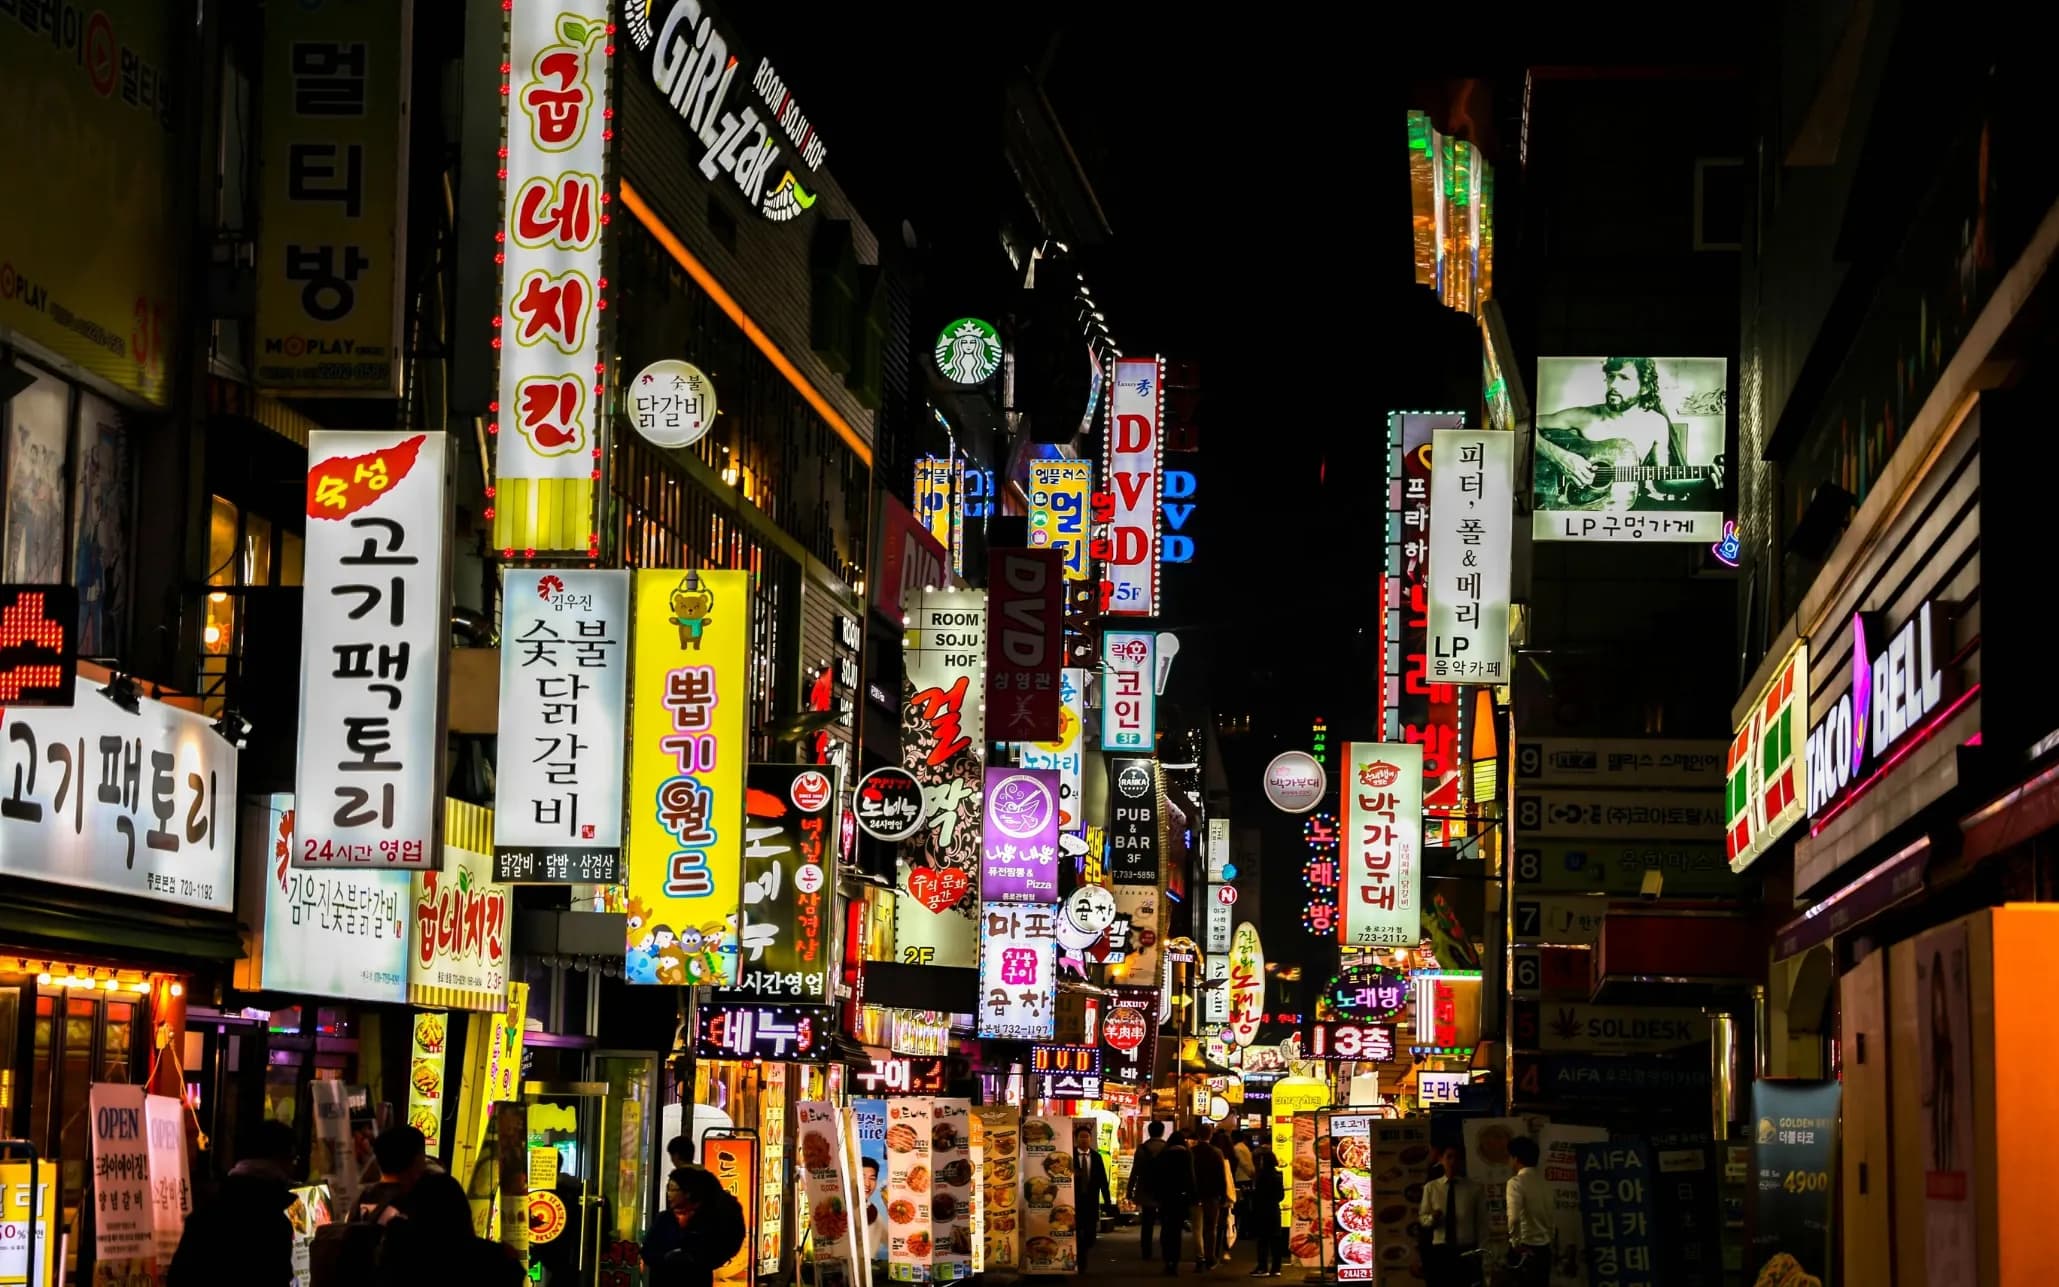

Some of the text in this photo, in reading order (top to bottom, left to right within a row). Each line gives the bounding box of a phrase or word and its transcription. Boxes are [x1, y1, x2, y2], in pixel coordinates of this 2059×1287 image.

[753, 57, 788, 113] ROOM
[287, 43, 368, 322] 멀티방
[517, 52, 591, 447] 굽네치킨
[671, 375, 703, 391] 숯불
[636, 394, 705, 428] 닭갈비
[315, 458, 387, 510] 숙성
[1035, 468, 1087, 485] 엠플러스
[1114, 414, 1151, 566] DVD
[1161, 470, 1197, 563] DVD
[1404, 478, 1429, 564] 프라하
[1565, 516, 1694, 539] LP 구멍가게
[1455, 442, 1487, 631] 피터, 폴 & 메리
[551, 593, 593, 612] 김우진
[1116, 582, 1142, 601] 5F
[932, 613, 979, 626] ROOM
[1003, 555, 1048, 668] DVD
[515, 619, 617, 668] 숯불
[935, 634, 978, 647] SOJU
[1435, 636, 1469, 658] LP
[331, 517, 419, 829] 고기팩토리
[945, 655, 978, 667] HOF
[1434, 661, 1501, 677] 음악카페
[1115, 670, 1142, 729] 코인
[1804, 599, 1942, 820] TACO BELL
[1120, 734, 1137, 743] 3F
[532, 674, 589, 837] 닭갈비
[1520, 746, 1539, 775] 9
[660, 670, 714, 895] 뽑기월드
[1270, 777, 1319, 790] 박가부대
[1, 721, 217, 870] 고기팩토리
[1117, 808, 1151, 821] PUB
[1520, 800, 1539, 827] 8
[1129, 823, 1137, 834] &
[304, 839, 423, 863] 24시간 영업
[1115, 836, 1151, 849] BAR
[1359, 792, 1401, 912] 박가부대
[501, 853, 615, 881] 닭갈비 닭발 삼겹살
[1127, 853, 1142, 864] 3F
[1520, 852, 1539, 880] 8
[941, 872, 967, 890] 문화
[1026, 879, 1052, 889] Pizza
[1309, 820, 1334, 930] 노래방
[181, 879, 213, 900] 720-1192
[929, 891, 953, 910] 공간
[417, 869, 505, 963] 굽네치킨
[1076, 899, 1113, 923] 곱창
[1519, 905, 1538, 932] 7
[988, 912, 1051, 939] 마포
[1358, 933, 1408, 943] 723-2112
[904, 946, 935, 964] 2F
[1005, 968, 1034, 984] 구이
[1517, 959, 1536, 985] 6
[987, 988, 1050, 1018] 곱창
[1113, 998, 1149, 1011] Luxury
[1229, 965, 1260, 1034] 노래방
[1337, 986, 1399, 1009] 노래방
[1002, 1024, 1048, 1035] 732-1197
[1105, 1027, 1145, 1040] 羊肉串
[1588, 1018, 1692, 1040] SOLDESK
[1335, 1026, 1390, 1059] 3층
[1036, 1049, 1089, 1071] DVD
[857, 1059, 910, 1091] 구이
[98, 1107, 139, 1139] OPEN
[1779, 1118, 1814, 1129] GOLDEN
[1584, 1151, 1643, 1172] AIFA
[1783, 1170, 1828, 1194] 4900
[1617, 1177, 1650, 1287] 아카데
